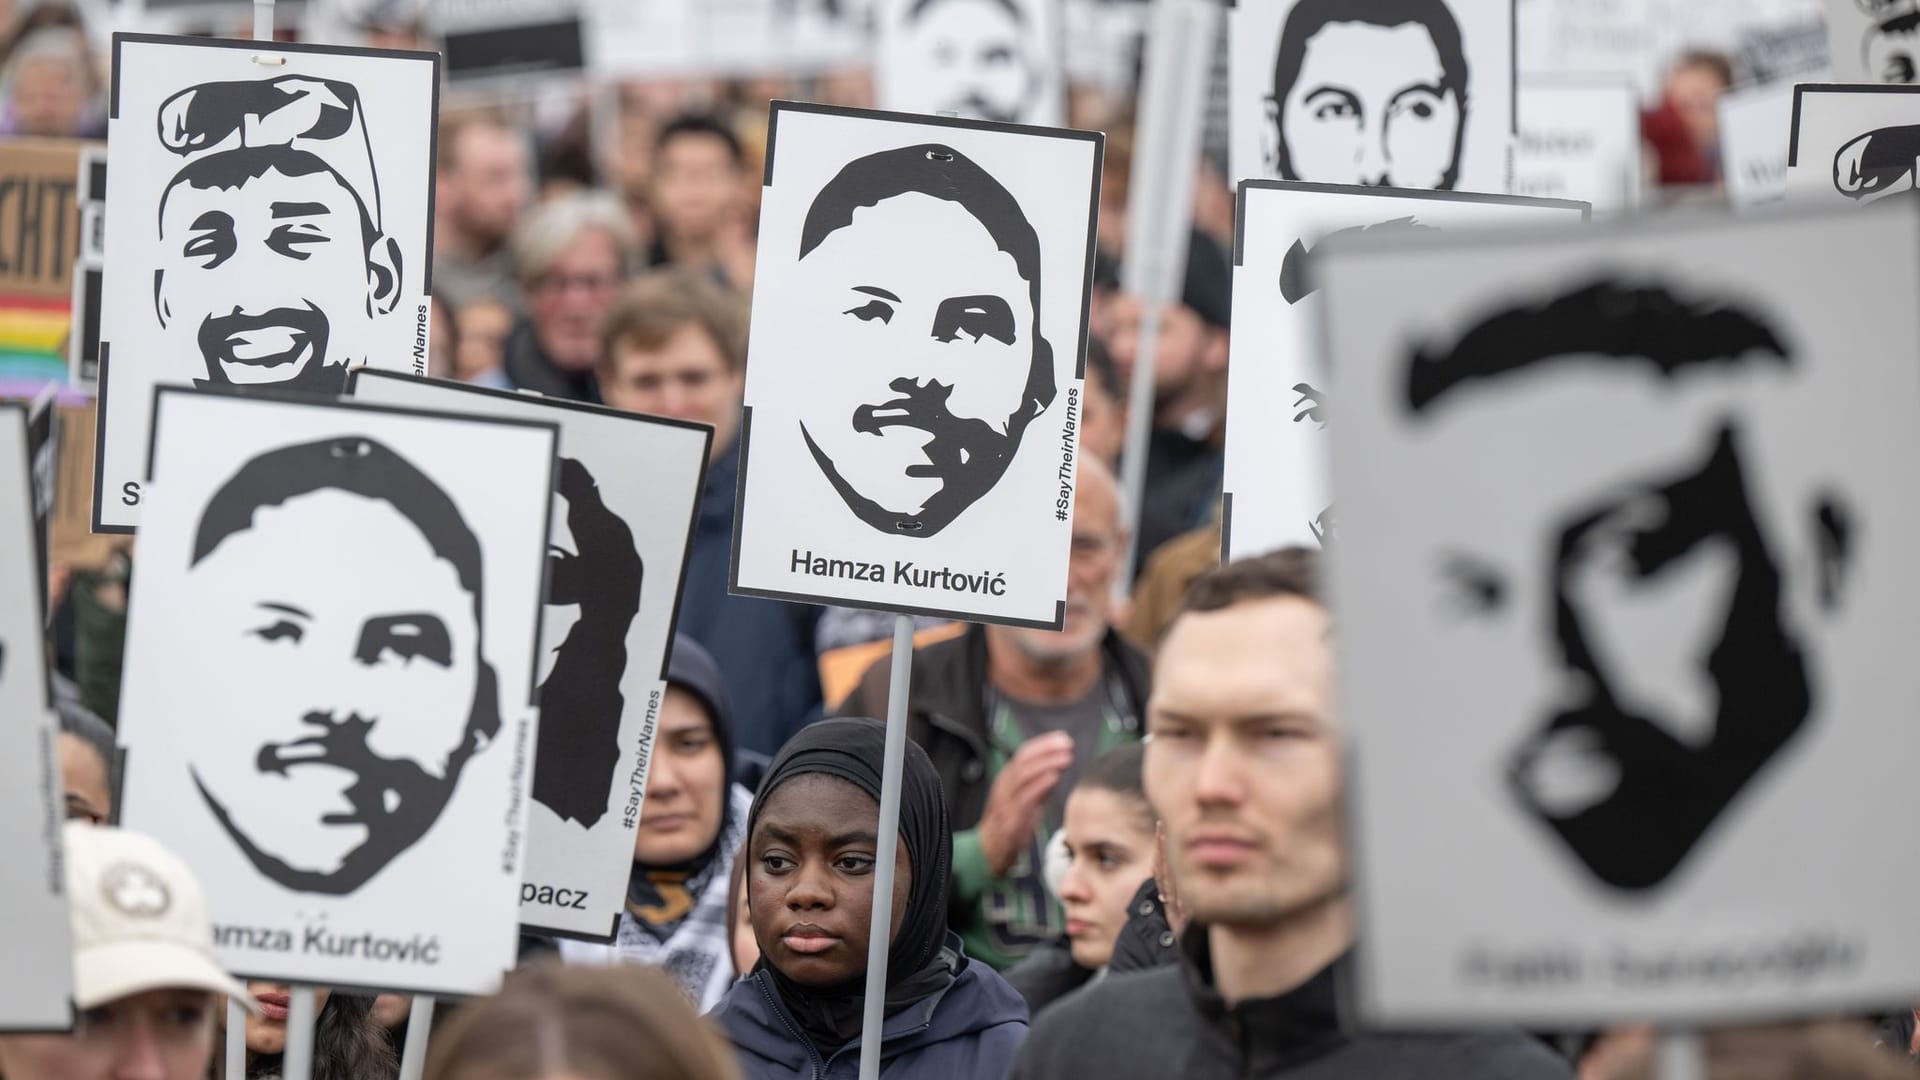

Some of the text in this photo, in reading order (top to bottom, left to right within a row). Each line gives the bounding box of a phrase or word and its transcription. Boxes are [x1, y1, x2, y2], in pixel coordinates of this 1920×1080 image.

[1056, 388, 1078, 522] #SayTheirNames
[791, 549, 1006, 597] Hamza Kurtović
[622, 690, 660, 830] #SayTheirNames
[302, 926, 441, 965] Kurtović
